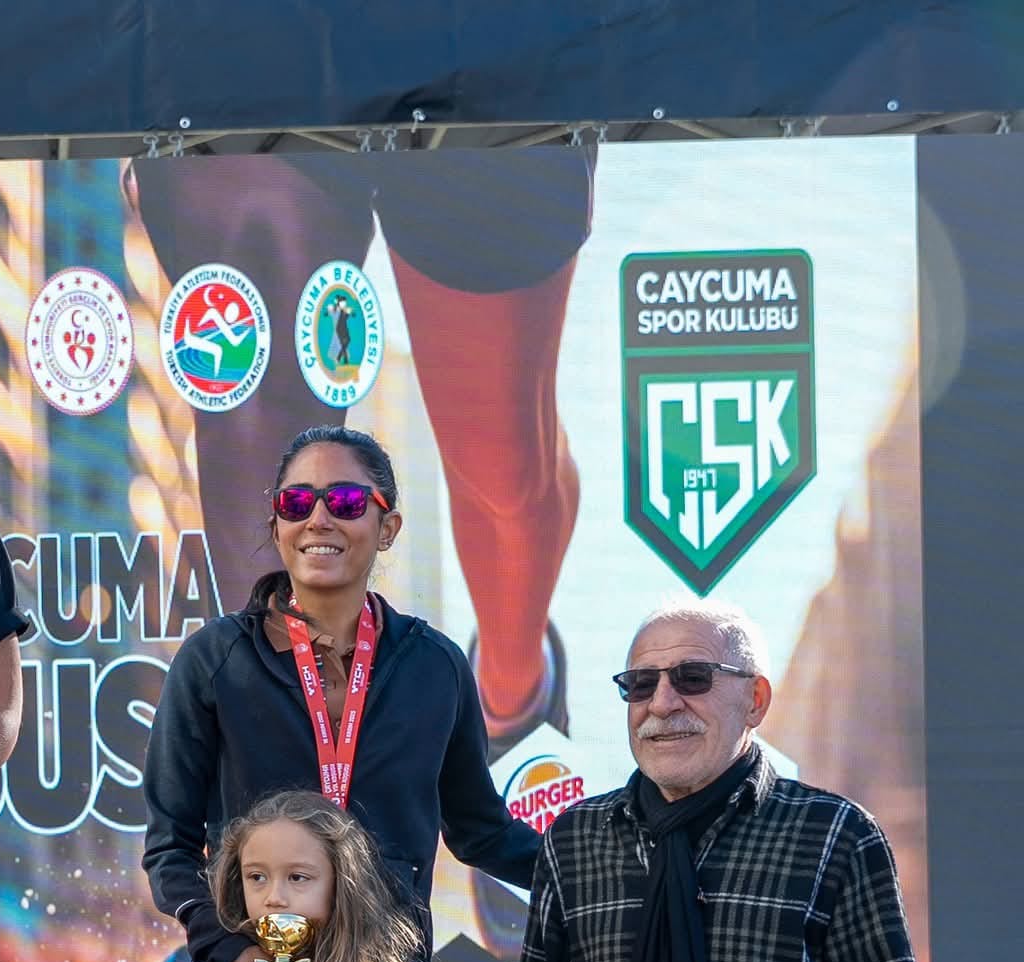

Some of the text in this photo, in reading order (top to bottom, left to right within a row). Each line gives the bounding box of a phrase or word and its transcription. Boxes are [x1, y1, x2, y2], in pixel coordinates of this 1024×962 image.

[638, 308, 702, 334] SPOR
[326, 385, 356, 402] 1889
[2, 529, 225, 646] CUMA
[509, 776, 584, 819] BURGER
